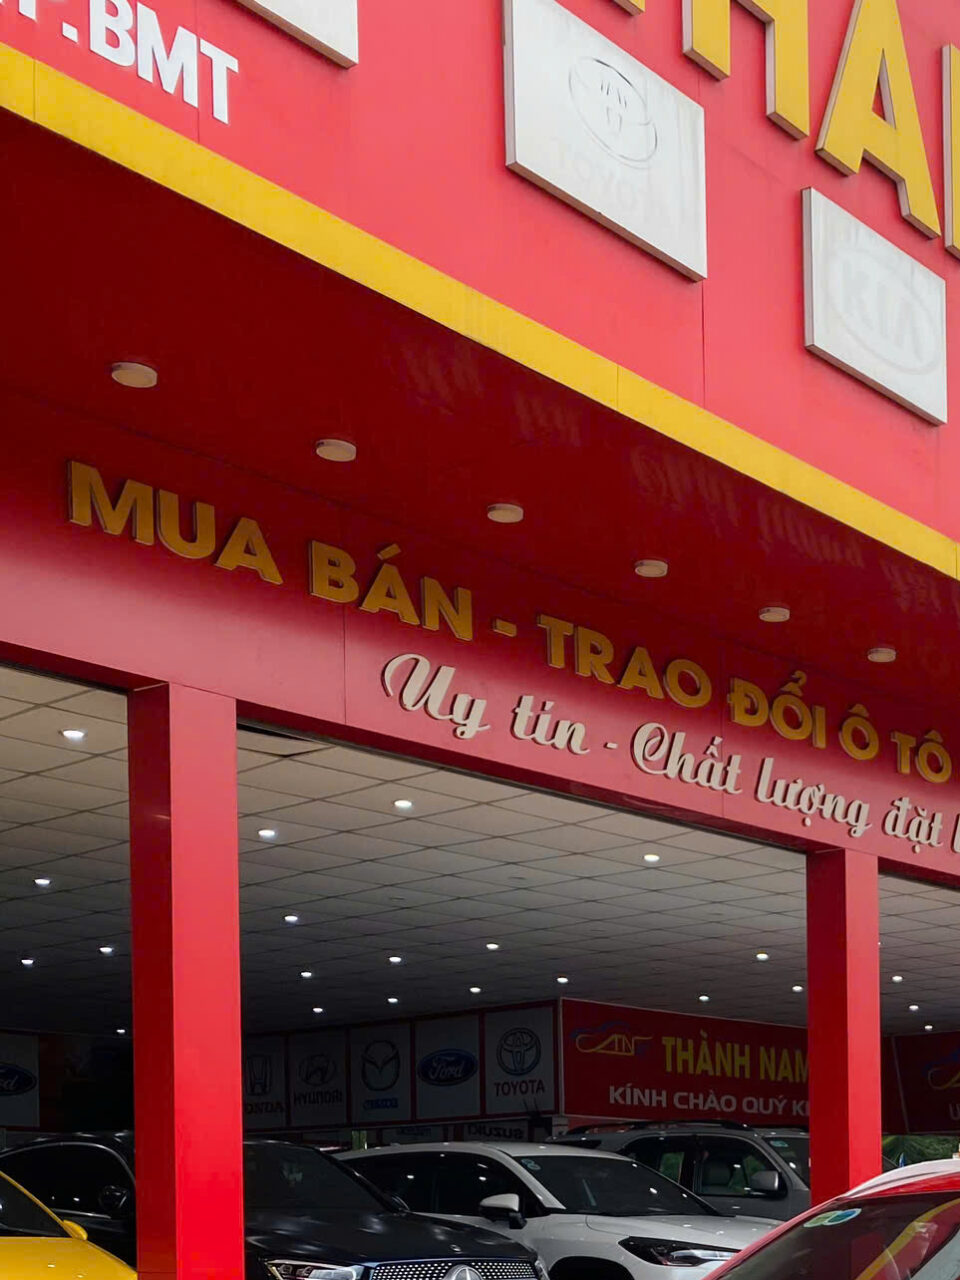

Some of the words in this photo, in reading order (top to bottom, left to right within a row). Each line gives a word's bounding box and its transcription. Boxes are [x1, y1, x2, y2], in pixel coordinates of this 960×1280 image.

[19, 0, 239, 125] .BMT
[67, 460, 284, 585] MUA
[309, 543, 474, 642] BÁN
[537, 613, 712, 709] TRAO
[727, 670, 826, 749] ĐỔI
[839, 703, 880, 761] Ô
[891, 729, 953, 784] TÔ
[381, 652, 490, 740] Uy
[511, 693, 591, 755] tín
[631, 722, 743, 795] Chất
[755, 756, 873, 838] lượng
[881, 796, 944, 854] đặt
[661, 1028, 750, 1080] THÀNH
[758, 1045, 808, 1085] NAM
[242, 1099, 283, 1114] ONDA
[494, 1079, 546, 1097] TOYOTA
[609, 1082, 668, 1109] KÍNH
[673, 1090, 737, 1114] CHÀO
[742, 1095, 788, 1117] QUÝ
